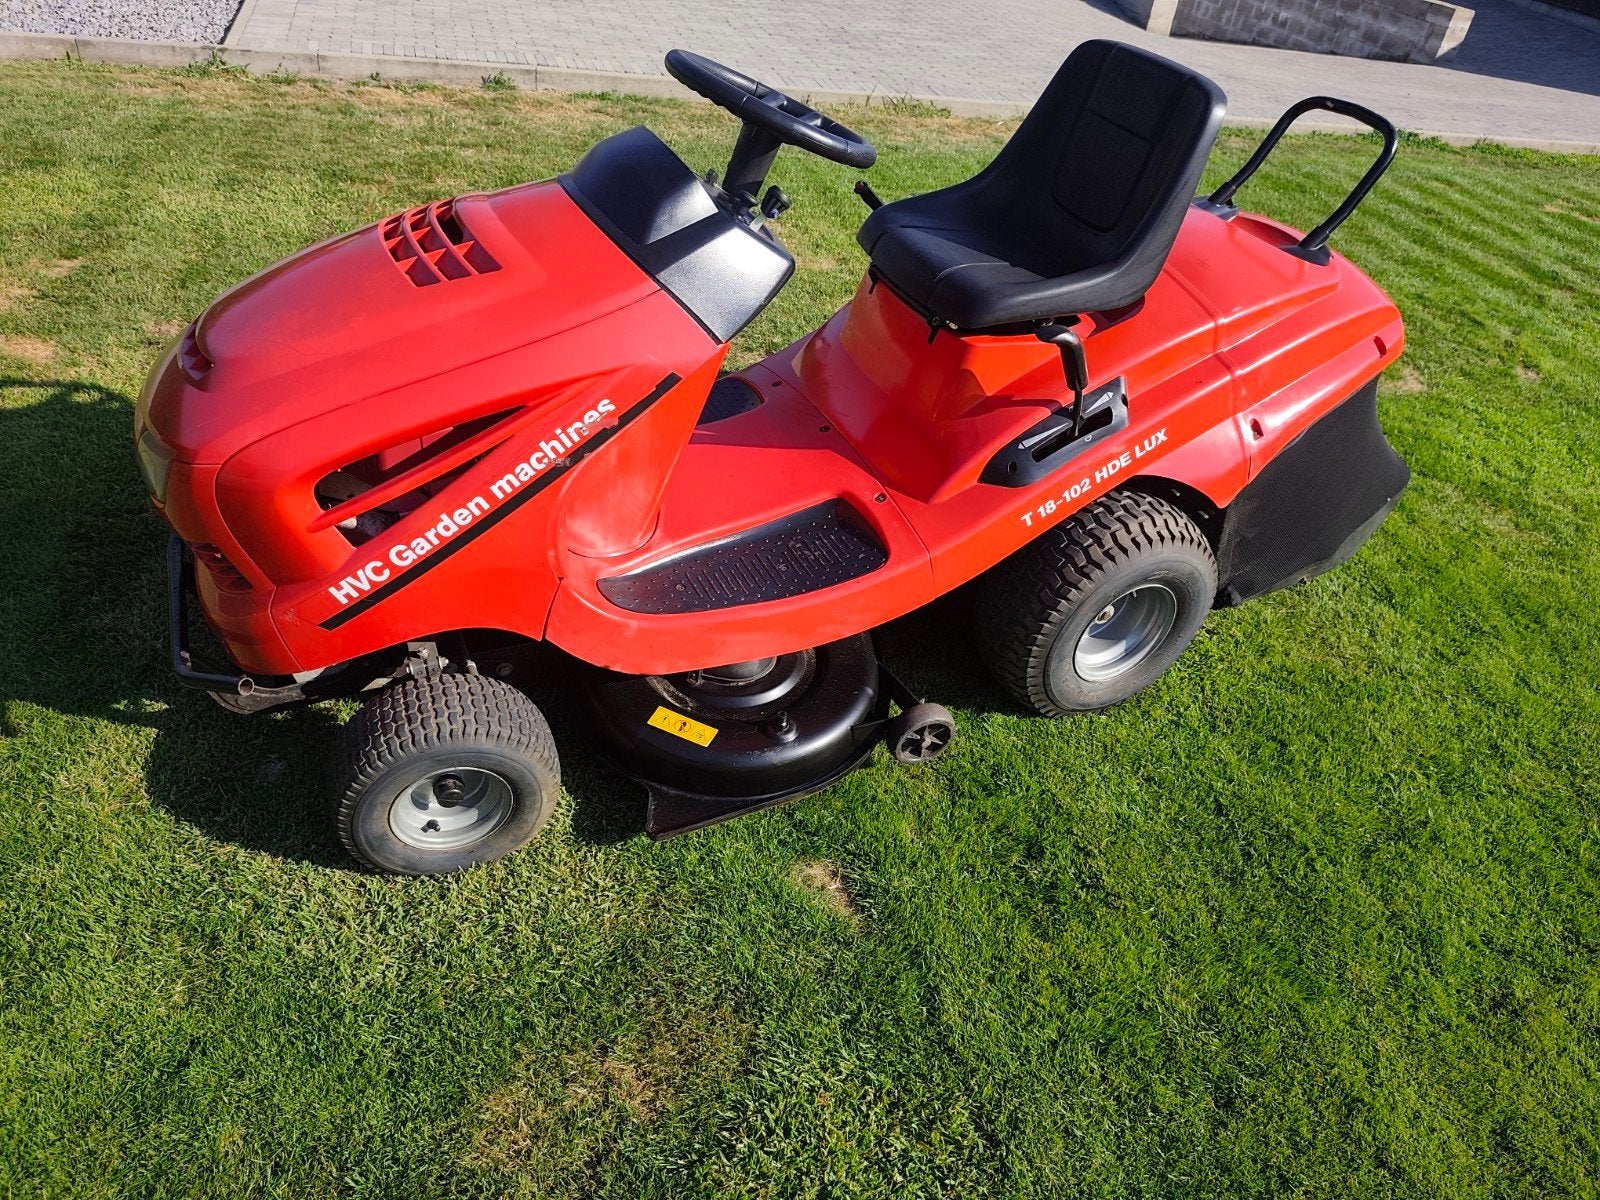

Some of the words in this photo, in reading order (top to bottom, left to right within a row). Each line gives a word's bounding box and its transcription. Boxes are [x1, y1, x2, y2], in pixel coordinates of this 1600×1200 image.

[328, 561, 391, 605] HVC
[388, 496, 491, 567] Garden
[489, 398, 616, 500] machines
[1020, 512, 1033, 527] T
[1036, 477, 1092, 518] 18-102
[1094, 451, 1133, 484] HDE
[1134, 427, 1168, 458] LUX
